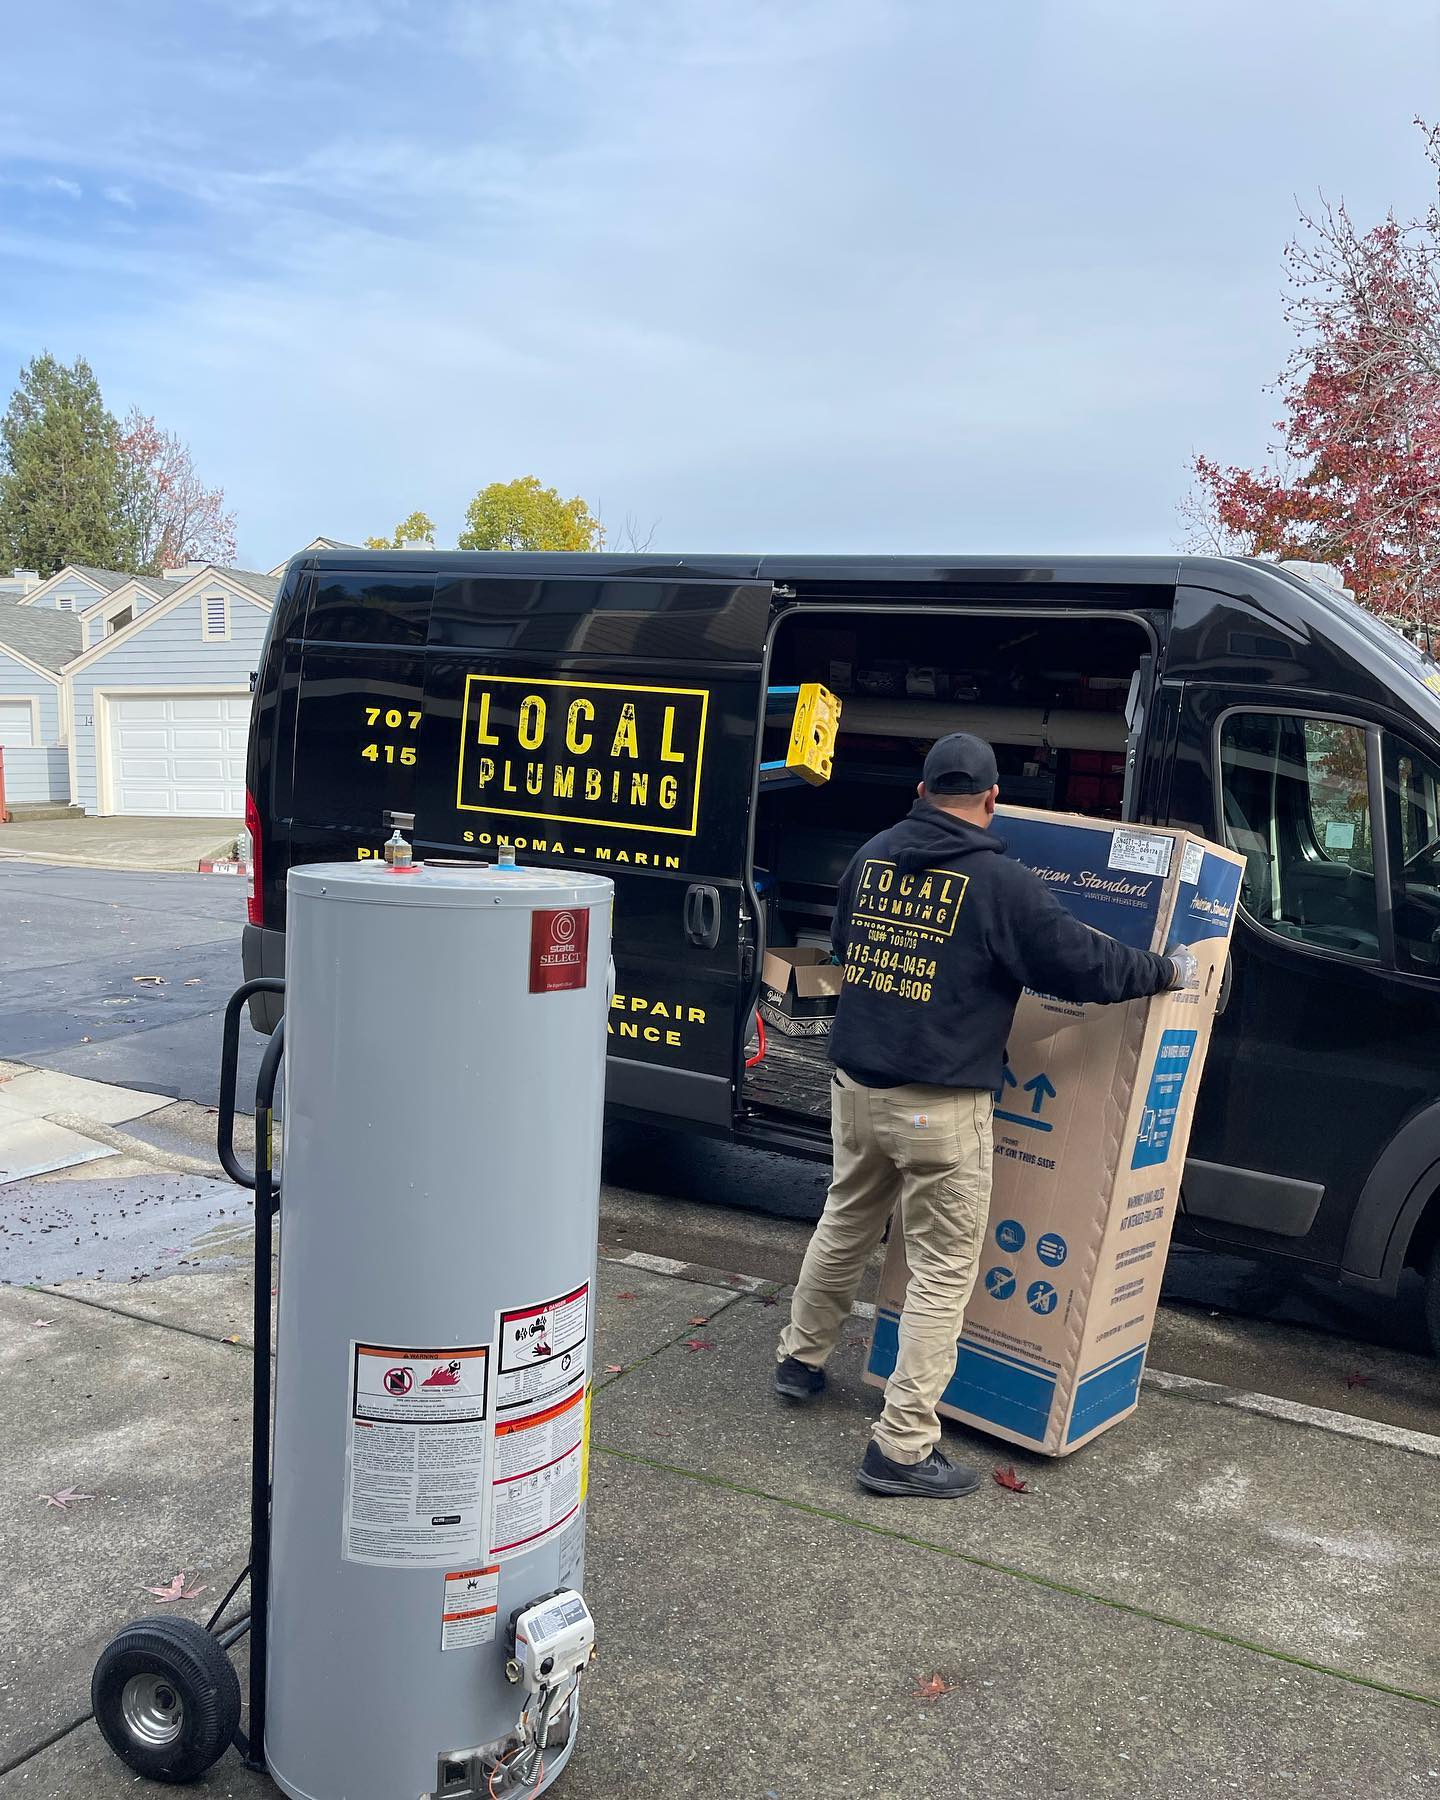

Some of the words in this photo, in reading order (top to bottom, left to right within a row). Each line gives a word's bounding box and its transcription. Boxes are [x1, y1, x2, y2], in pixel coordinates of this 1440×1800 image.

[365, 707, 422, 729] 707
[477, 692, 685, 763] LOCAL
[361, 743, 417, 766] 415
[479, 757, 678, 810] PLUMBING
[463, 830, 565, 854] SONOMA
[595, 847, 681, 869] MARIN
[862, 866, 953, 905] LOCAL
[1073, 871, 1153, 898] Standard
[858, 894, 948, 924] PLUMBING
[851, 919, 895, 933] SONOMA
[905, 930, 945, 944] MARIN
[540, 953, 580, 964] SELECT
[550, 944, 575, 953] state
[846, 942, 937, 980] 415-484-0454
[1037, 1156, 1056, 1170] SIDE
